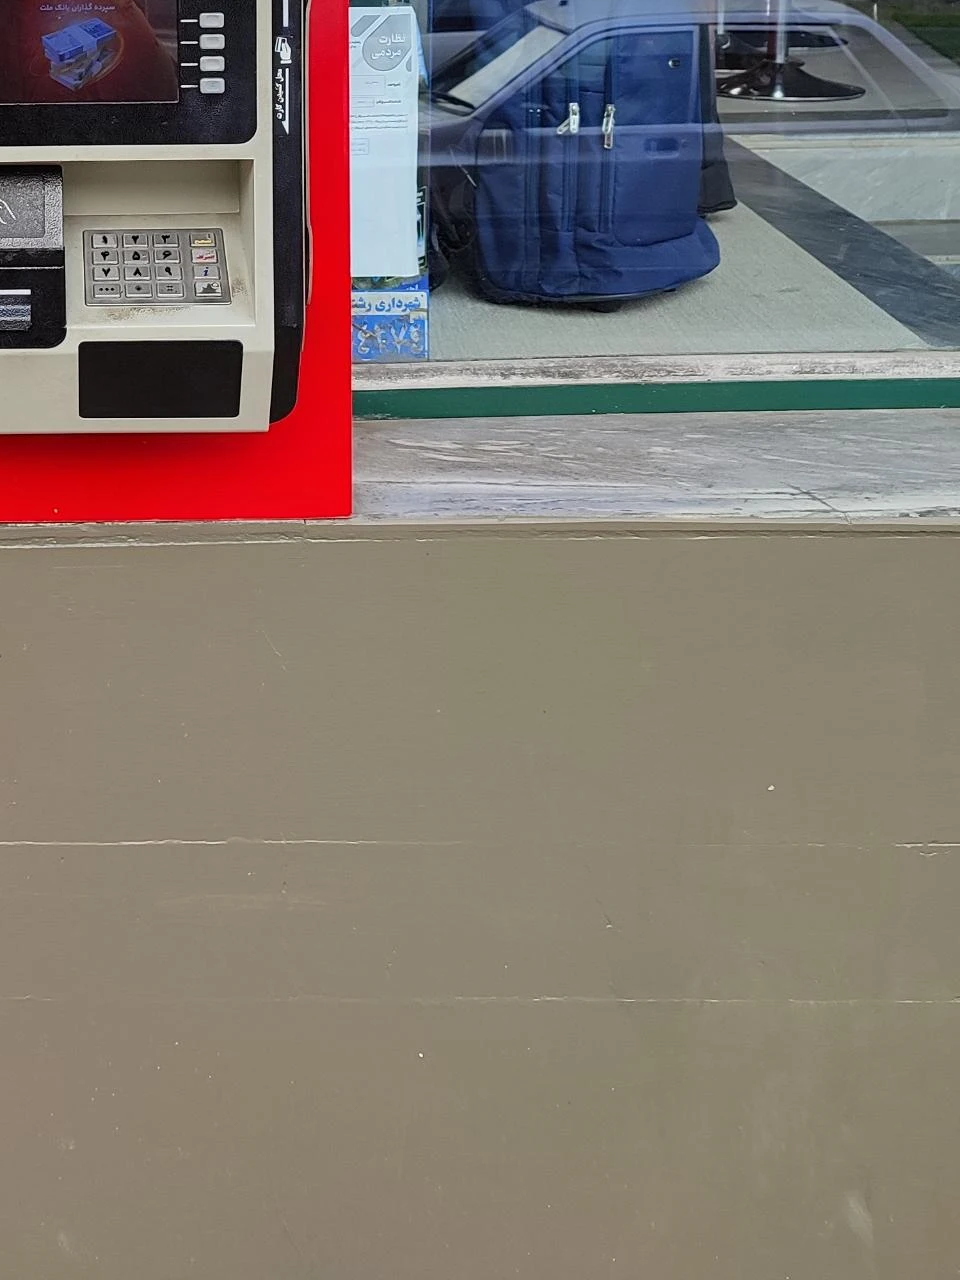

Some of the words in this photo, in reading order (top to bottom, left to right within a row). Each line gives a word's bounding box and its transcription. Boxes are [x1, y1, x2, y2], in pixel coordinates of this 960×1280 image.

[39, 4, 54, 12] ملت
[54, 3, 69, 12] بانک
[94, 4, 116, 13] سپرده
[378, 32, 407, 46] نظارت
[371, 48, 401, 60] مردمی
[375, 297, 421, 312] شهرداری
